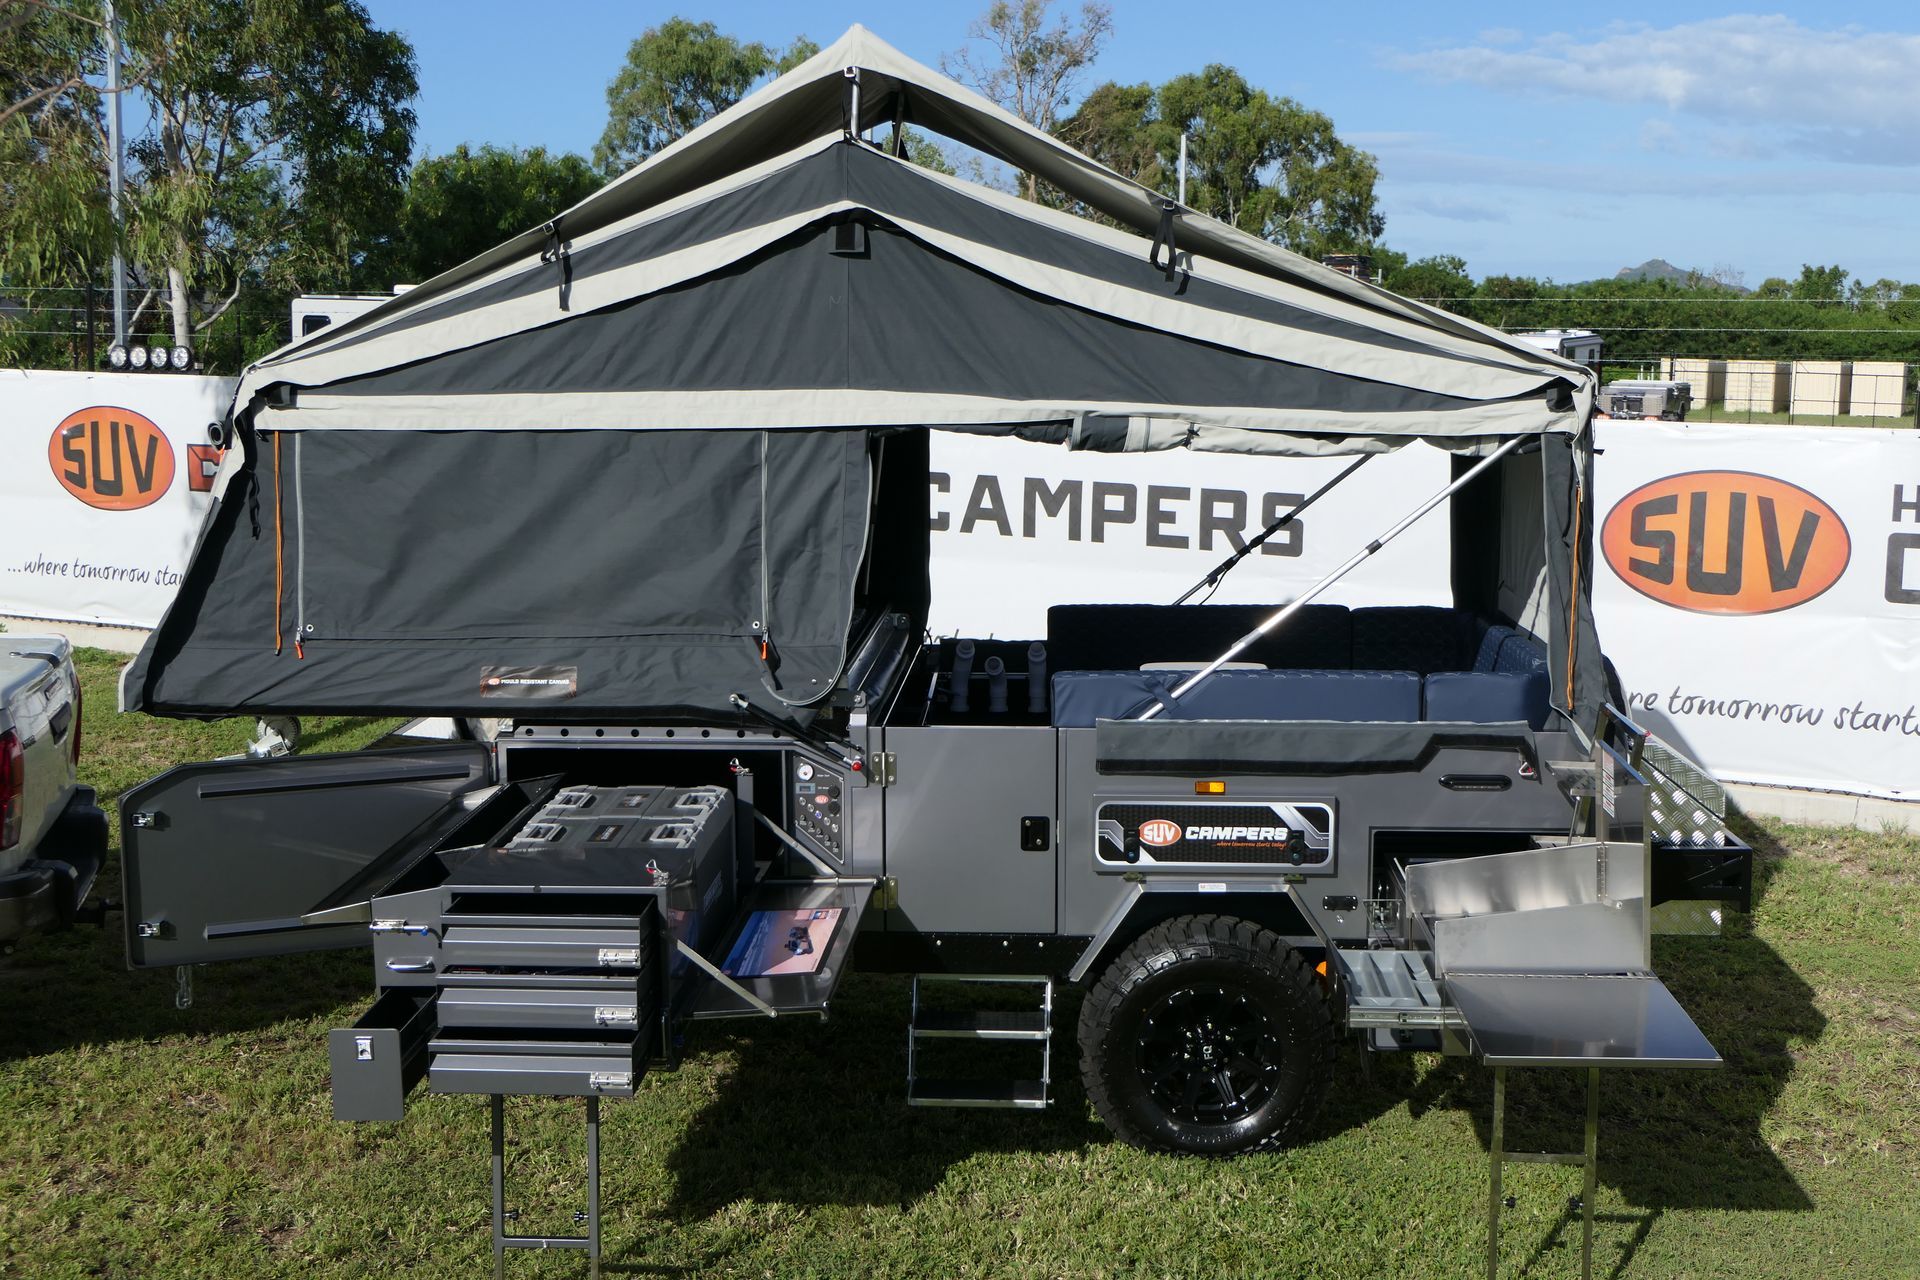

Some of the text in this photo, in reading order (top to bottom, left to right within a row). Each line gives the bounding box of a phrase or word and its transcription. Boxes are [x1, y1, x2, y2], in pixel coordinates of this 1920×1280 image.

[62, 421, 159, 497] SUV
[1628, 491, 1821, 596] SUV
[73, 557, 151, 584] tomorrow
[1668, 686, 1824, 727] tomorrow
[1143, 823, 1289, 843] SUV CAMPERS
